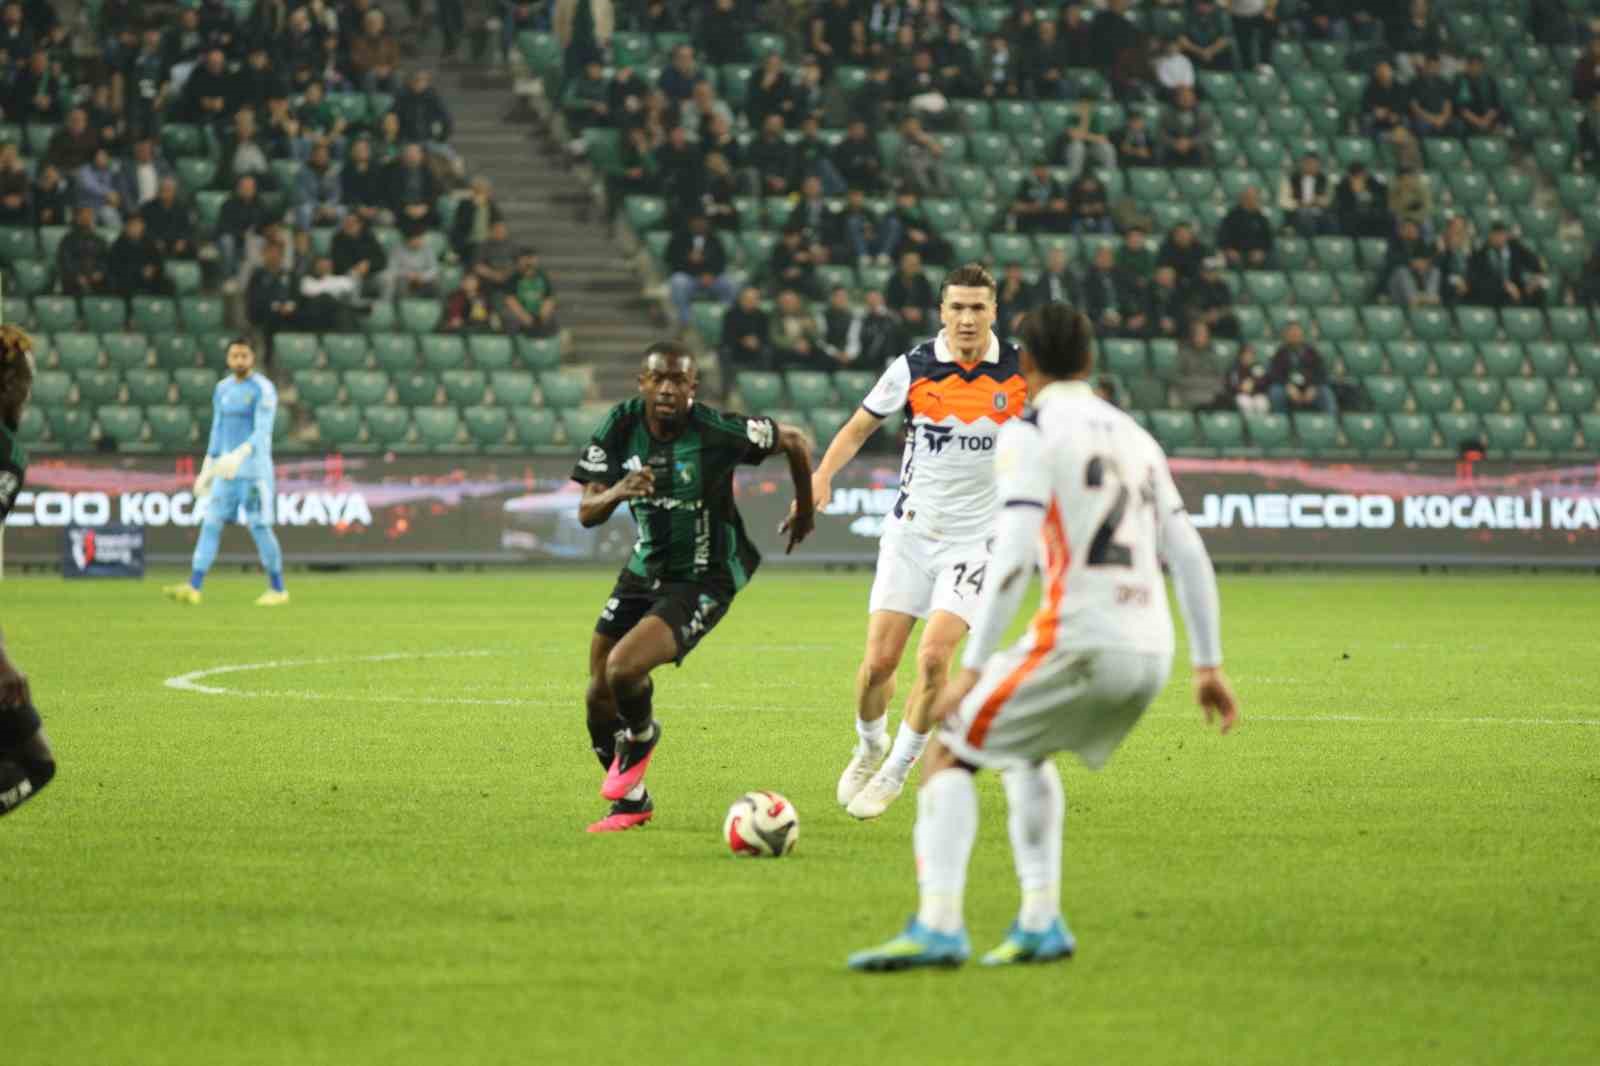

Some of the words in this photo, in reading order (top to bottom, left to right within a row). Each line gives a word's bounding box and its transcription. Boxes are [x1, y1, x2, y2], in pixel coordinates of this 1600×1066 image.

[958, 436, 994, 450] TOD
[120, 491, 209, 526] KOCA
[277, 493, 373, 526] KAYA
[1403, 487, 1543, 529] KOCAELİ
[1550, 495, 1600, 530] KA
